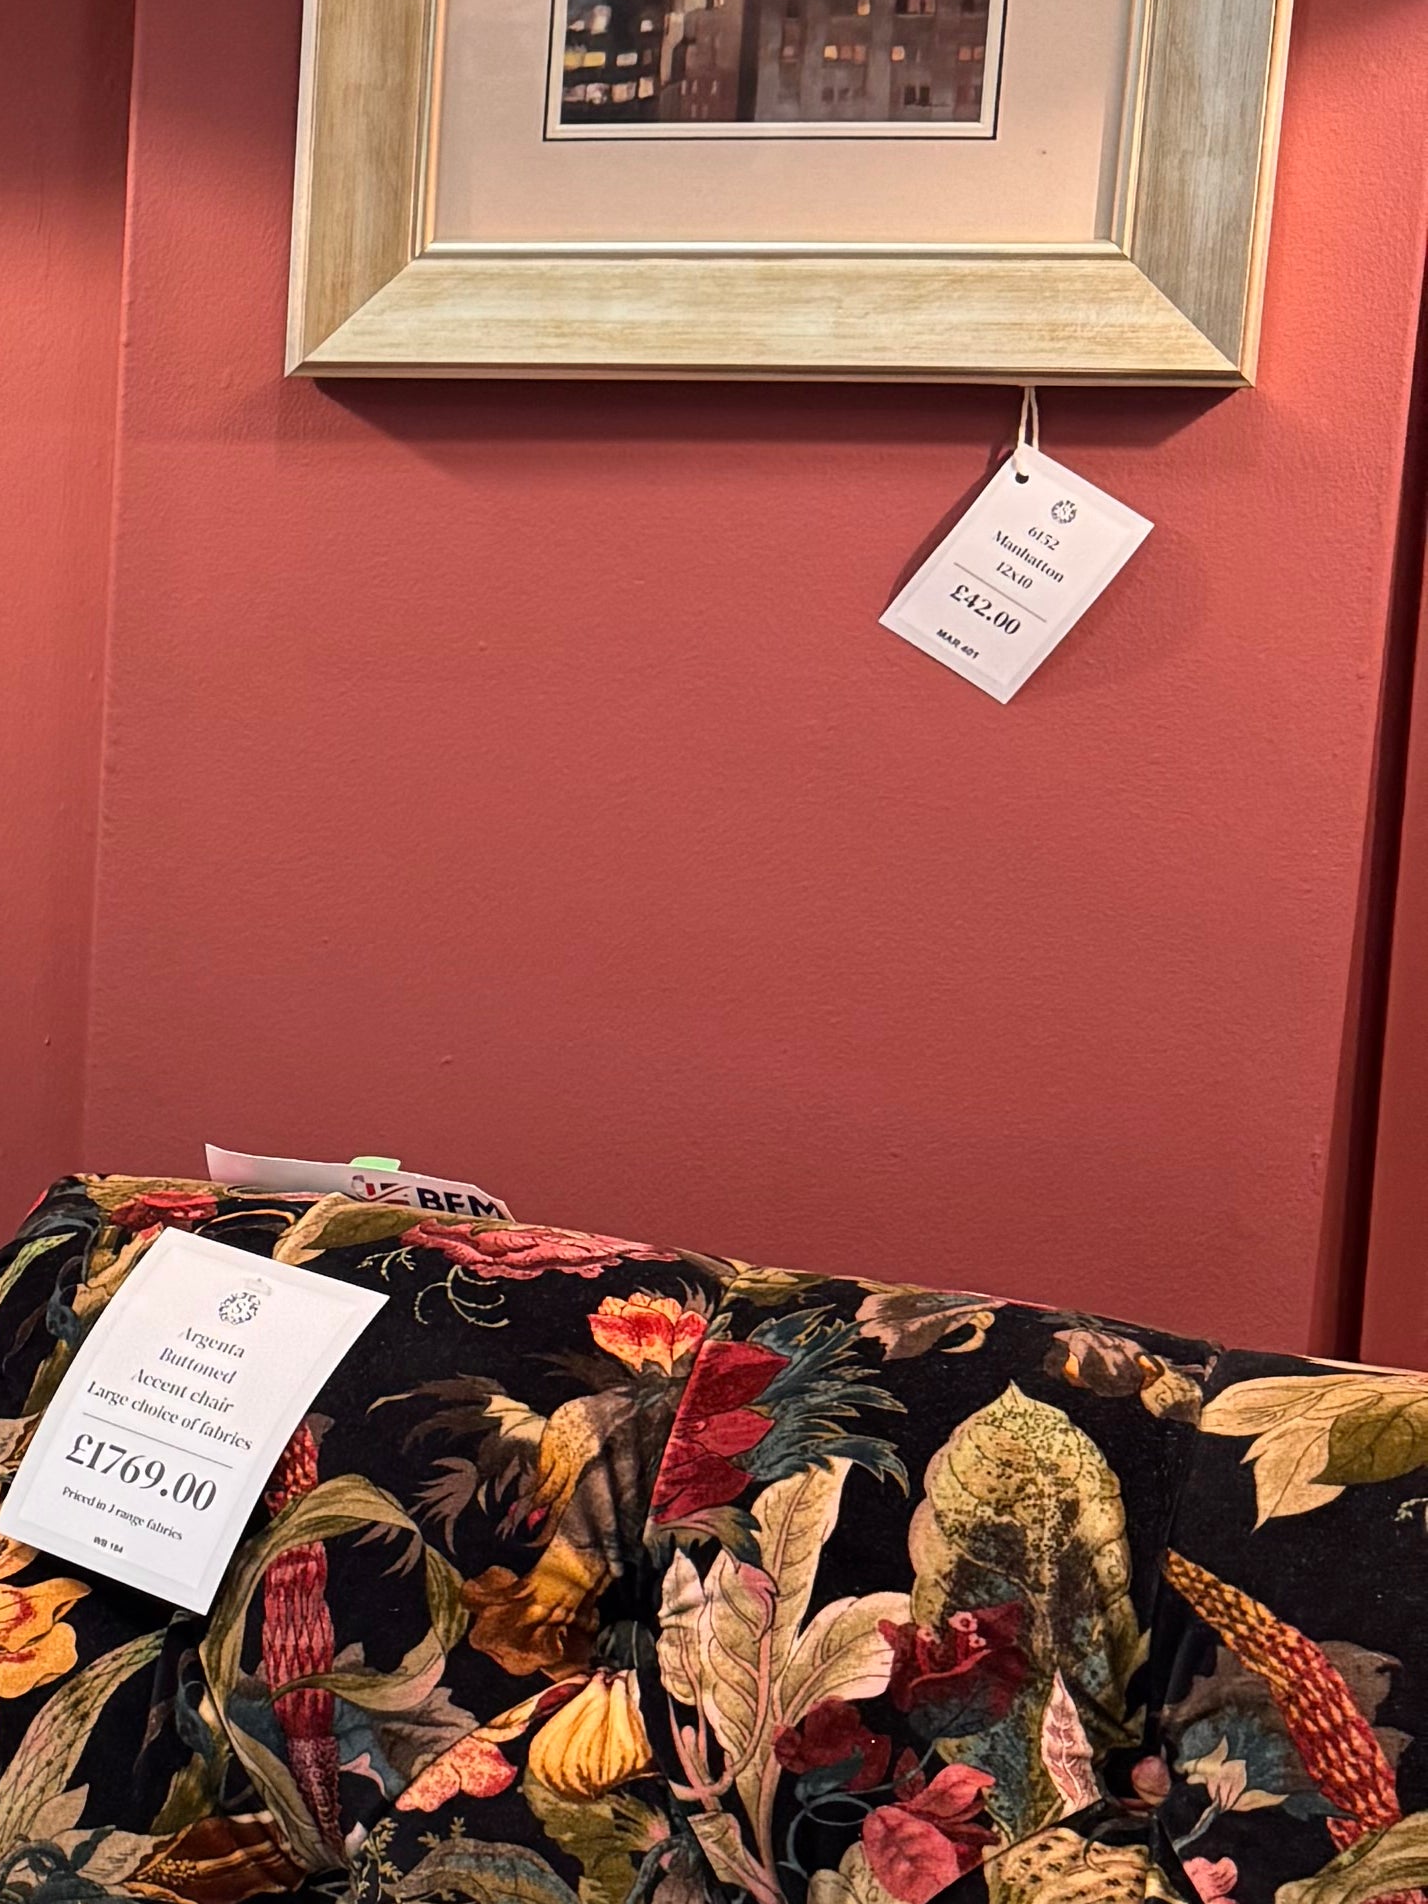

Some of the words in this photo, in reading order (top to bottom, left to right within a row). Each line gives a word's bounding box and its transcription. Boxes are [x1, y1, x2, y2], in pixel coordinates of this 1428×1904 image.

[993, 530, 1065, 583] Manhatton
[1028, 527, 1060, 551] 6152
[996, 561, 1034, 589] 12x10
[950, 584, 1021, 635] £42.00
[936, 628, 961, 648] MAR
[961, 646, 979, 659] 401
[416, 1187, 508, 1220] BFM
[178, 1327, 245, 1358] Argenta
[159, 1347, 237, 1384] Buttoned
[131, 1369, 188, 1399] Accent
[190, 1390, 234, 1413] chair
[87, 1381, 129, 1406] Large
[131, 1399, 179, 1424] choice
[181, 1416, 201, 1430] of
[199, 1421, 253, 1450] fabrics
[65, 1433, 216, 1511] £1769.00
[62, 1486, 95, 1507] Priced
[96, 1498, 106, 1510] in
[115, 1509, 145, 1527] range
[146, 1518, 183, 1541] fabrics
